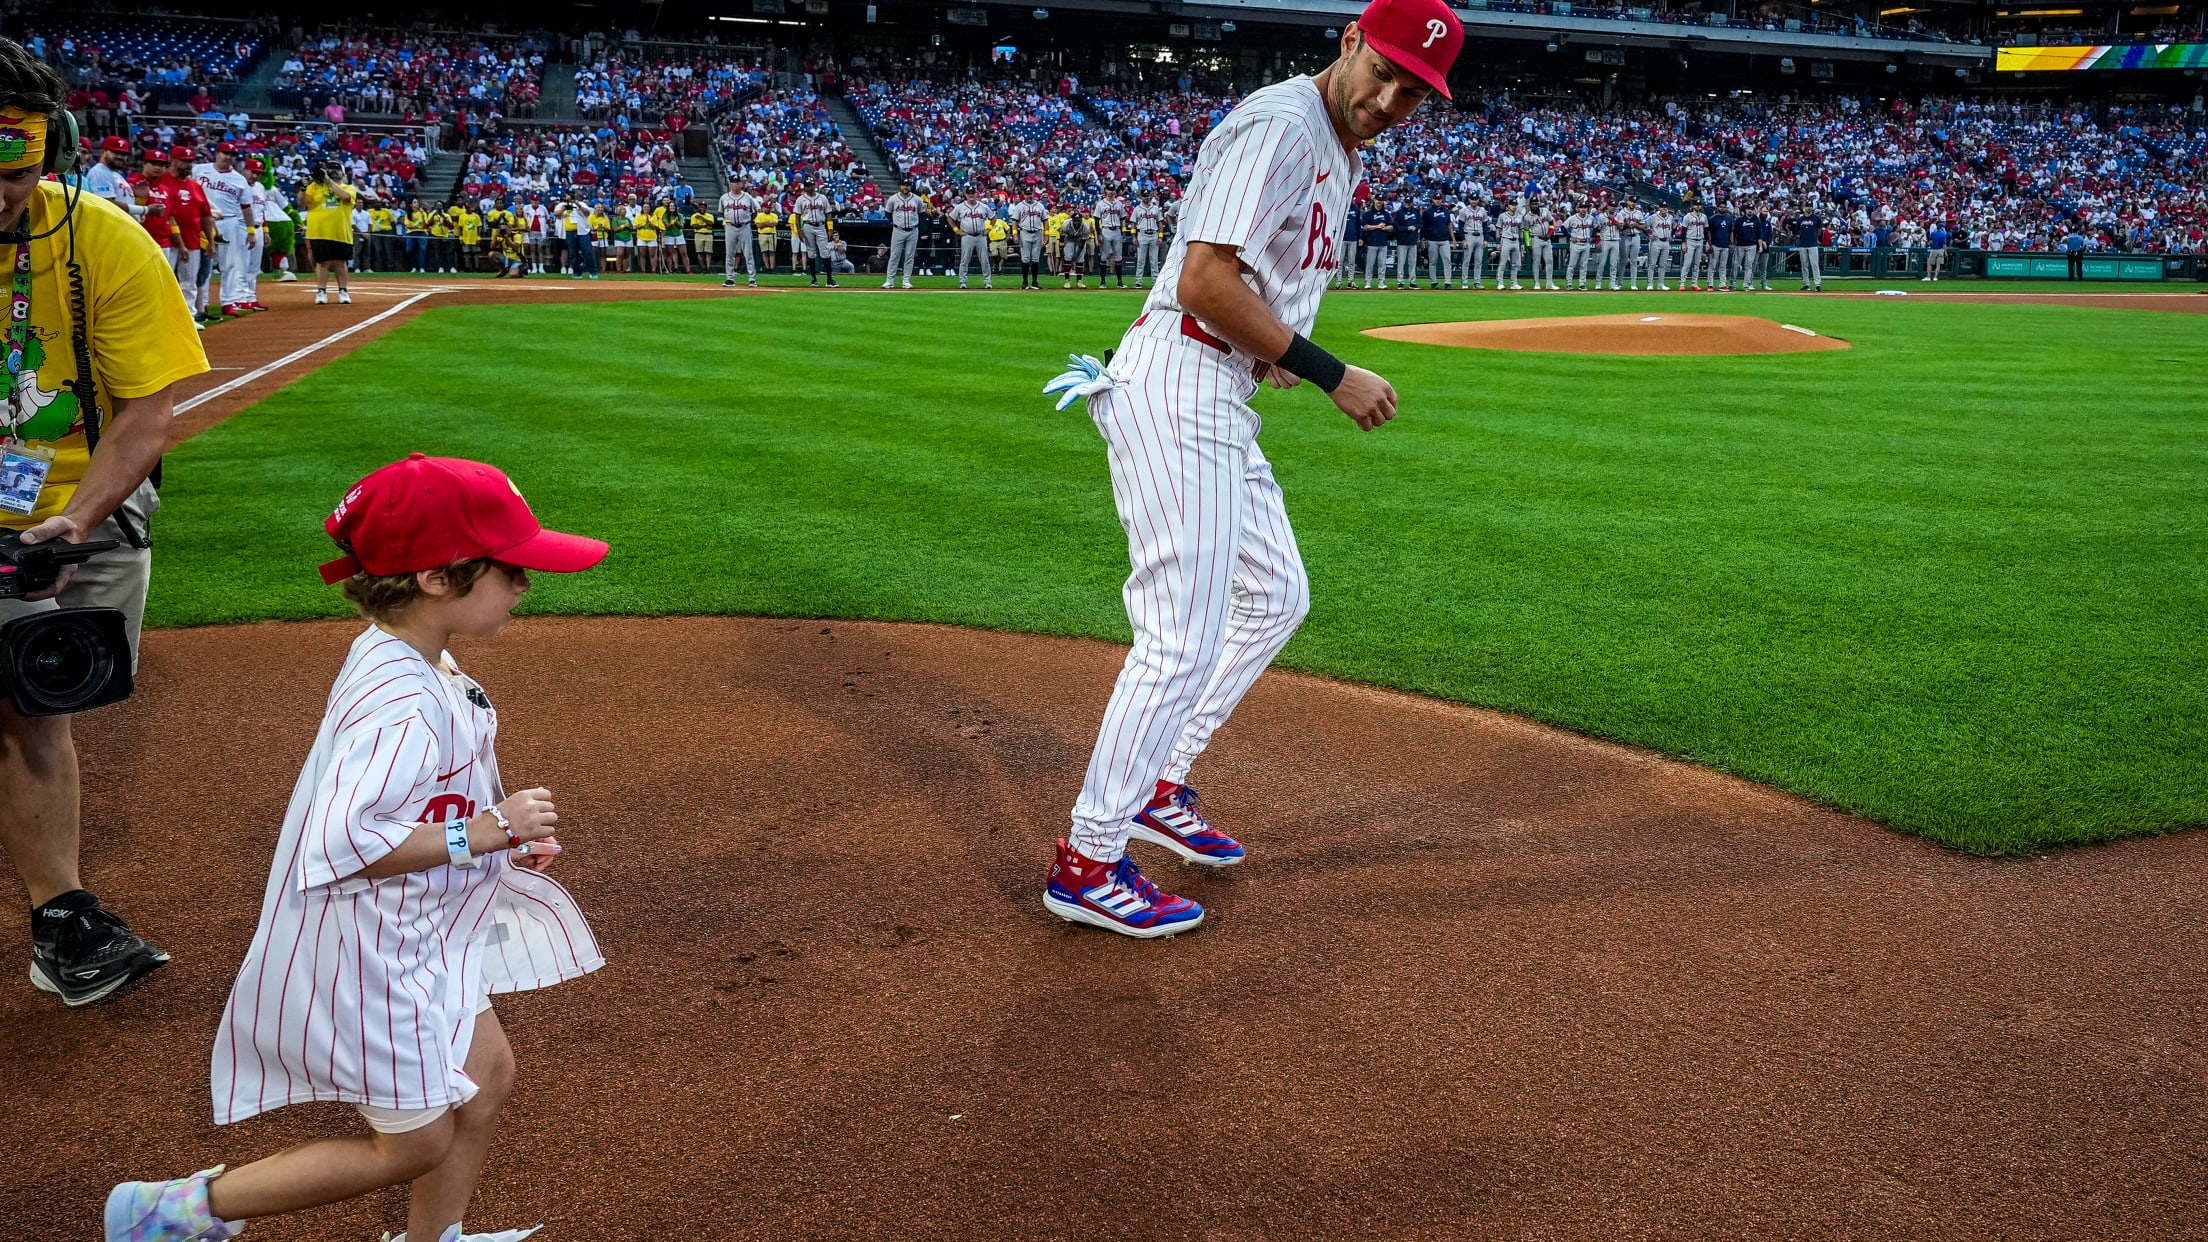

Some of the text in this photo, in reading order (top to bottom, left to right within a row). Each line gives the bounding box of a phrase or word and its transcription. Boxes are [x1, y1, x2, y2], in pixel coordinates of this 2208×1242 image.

[1422, 19, 1448, 48] P
[199, 176, 238, 196] Phillies
[1052, 864, 1061, 876] 7
